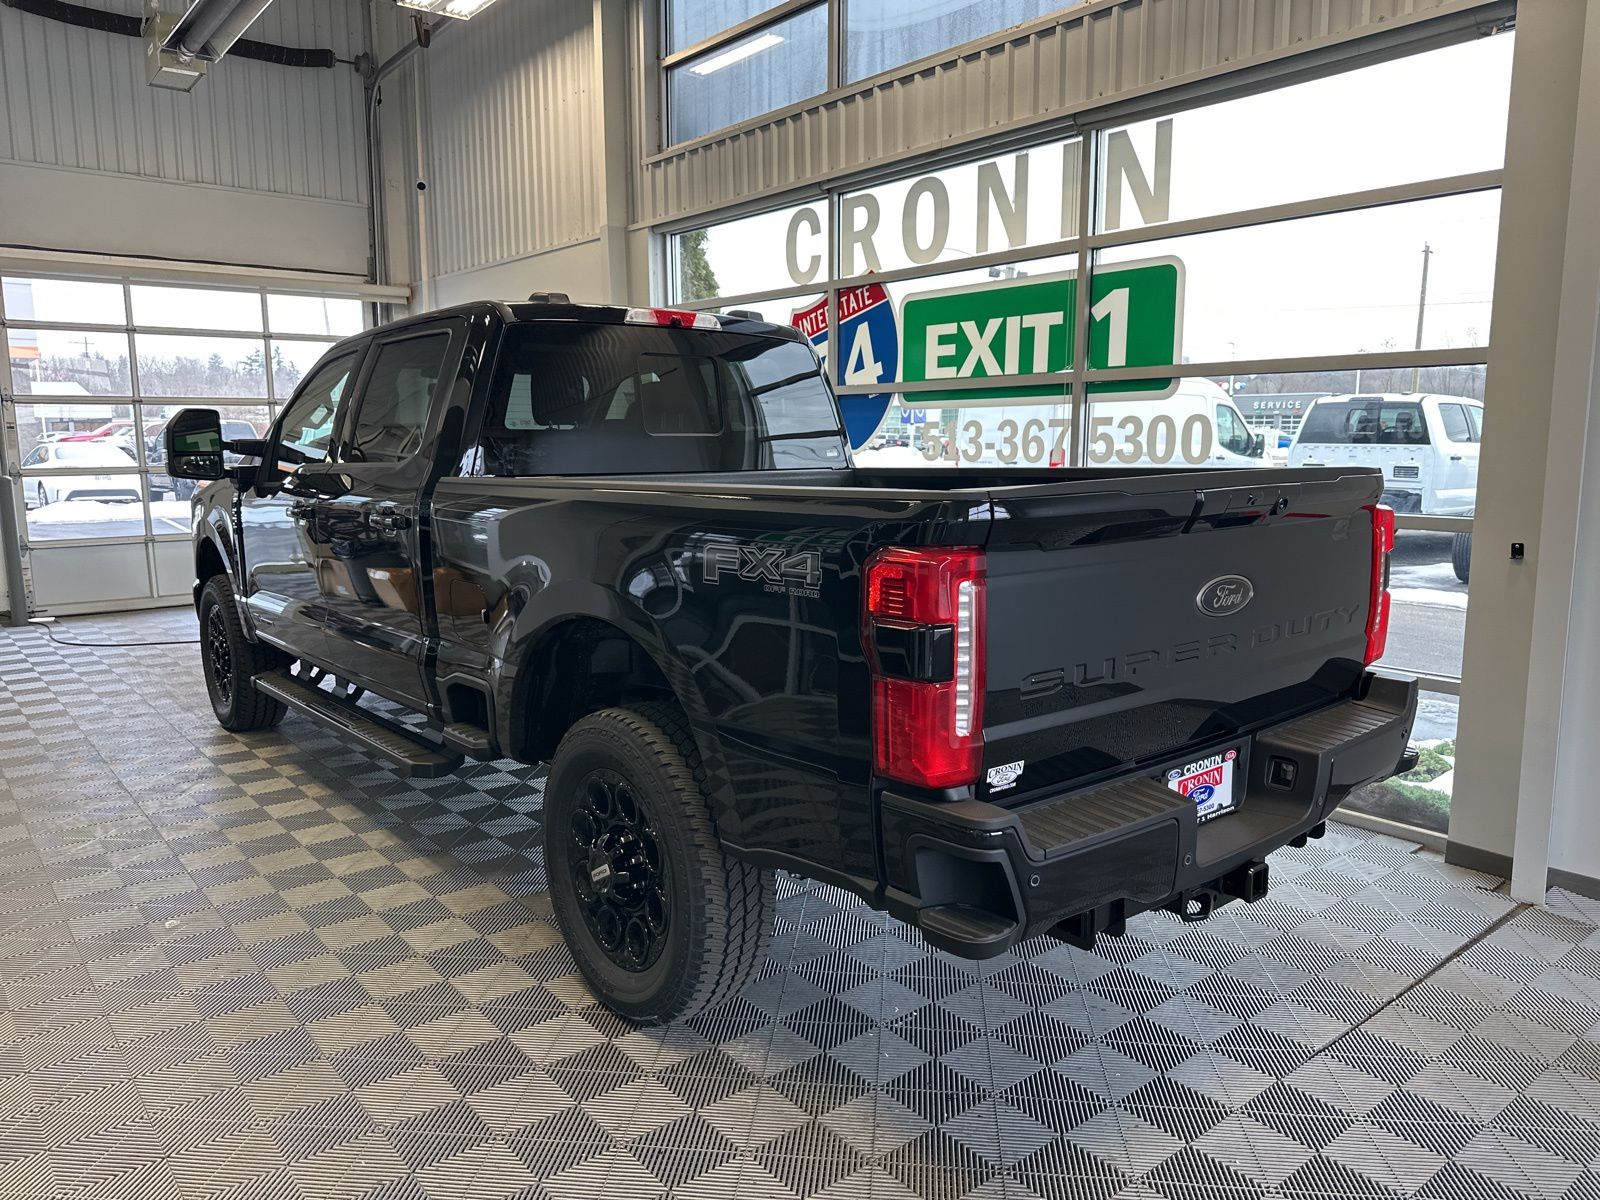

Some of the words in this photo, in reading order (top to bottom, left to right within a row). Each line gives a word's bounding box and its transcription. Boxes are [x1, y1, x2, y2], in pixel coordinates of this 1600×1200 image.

[785, 118, 1173, 285] CRONIN
[799, 285, 873, 334] INTETATE
[925, 311, 1063, 380] EXIT
[1091, 287, 1130, 367] 1
[1253, 400, 1301, 409] SERVICE
[703, 543, 822, 589] FX4
[1213, 584, 1243, 608] Ford
[1020, 632, 1238, 700] SUPER
[1252, 604, 1360, 648] DUTY
[988, 762, 1023, 778] CRONIN
[1184, 754, 1222, 775] CRONIN
[1180, 769, 1221, 796] CRONIN
[1192, 787, 1210, 803] Ford
